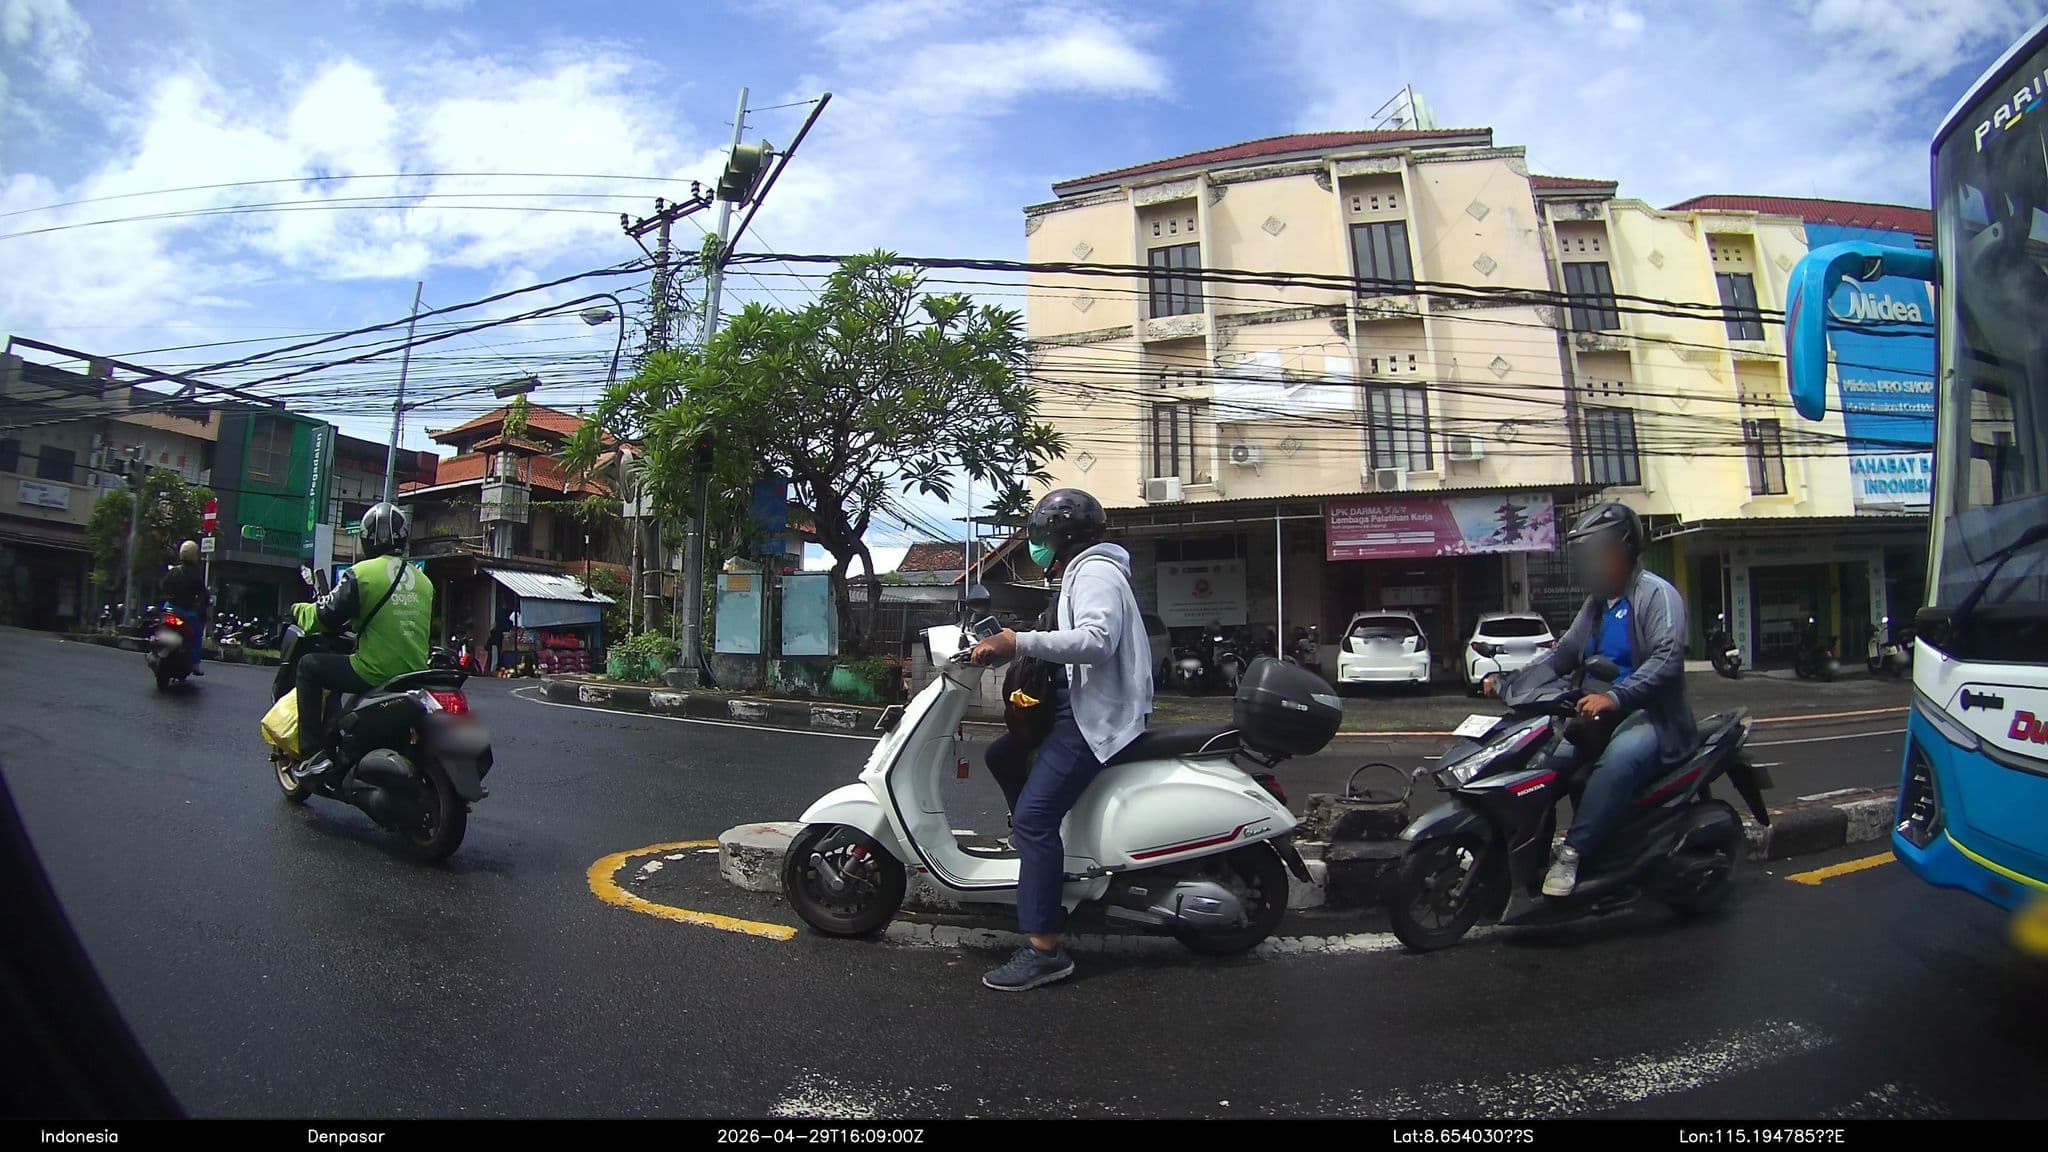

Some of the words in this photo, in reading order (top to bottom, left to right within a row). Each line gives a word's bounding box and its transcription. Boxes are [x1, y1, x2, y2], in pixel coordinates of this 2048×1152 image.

[1974, 68, 2048, 153] PARI
[1847, 290, 1922, 323] Midea
[1877, 380, 1901, 393] PRO
[309, 433, 322, 497] Pegadaian
[1331, 507, 1349, 517] LPK
[1350, 506, 1382, 516] DARMA
[1331, 515, 1369, 526] Lembaga
[1371, 513, 1409, 523] Pelatihan
[1411, 512, 1433, 522] Kerja
[391, 592, 419, 606] gojek
[2007, 710, 2048, 745] Du
[1517, 783, 1545, 797] HONDA
